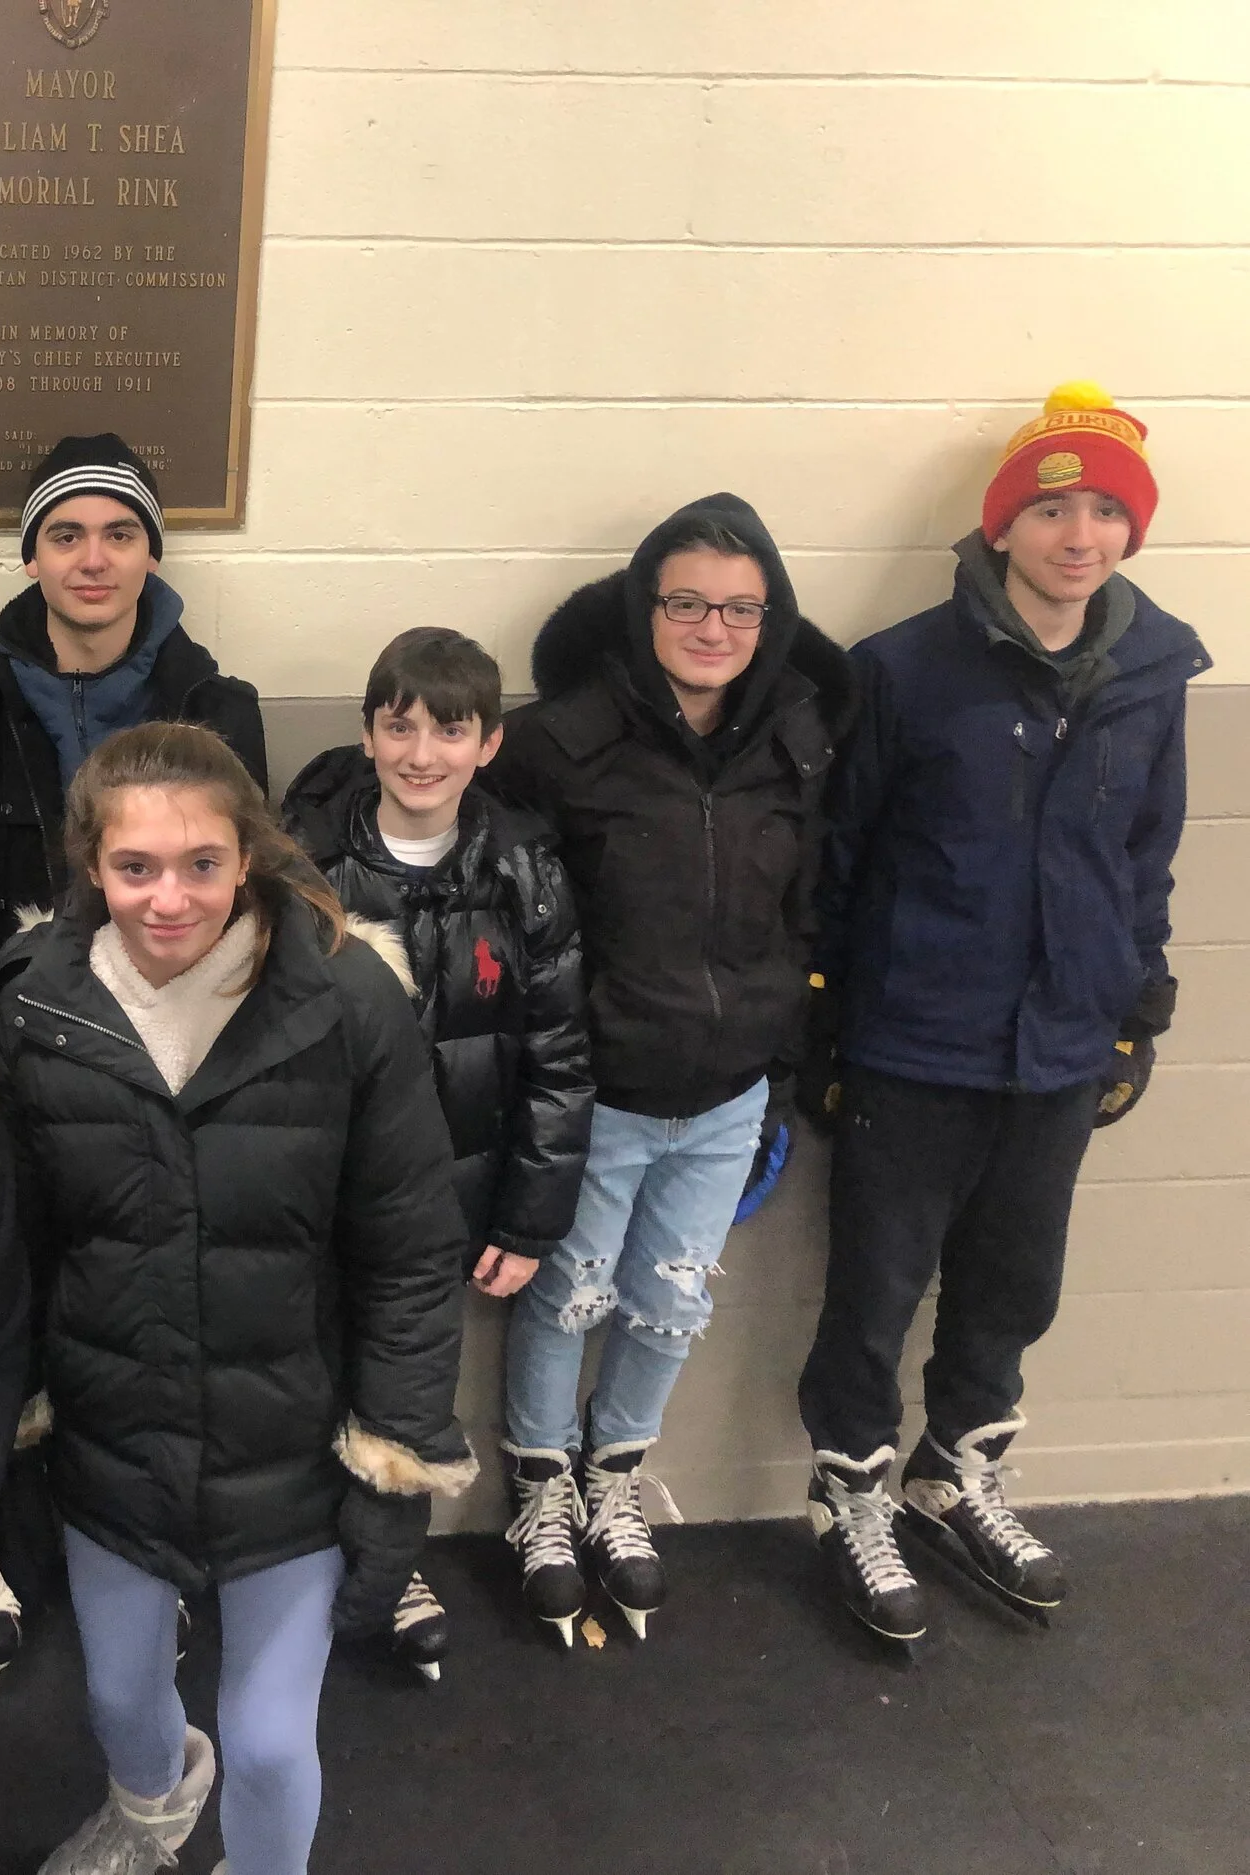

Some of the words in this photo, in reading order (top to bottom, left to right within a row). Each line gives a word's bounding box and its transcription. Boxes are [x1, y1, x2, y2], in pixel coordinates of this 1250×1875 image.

[25, 69, 117, 100] MAYOR
[119, 124, 186, 154] SHEA
[117, 177, 179, 207] RINK
[63, 244, 102, 261] 1962
[114, 245, 134, 261] BY
[144, 245, 175, 262] THE
[40, 270, 116, 287] DISTRICT
[125, 271, 226, 288] COMMISSION
[1, 325, 18, 341] IN
[29, 325, 99, 341] MEMORY
[109, 325, 129, 341] OF
[33, 350, 83, 367] CHIEF
[94, 351, 181, 367] EXECUTIVE
[29, 376, 103, 392] THROUGH
[116, 376, 151, 392] 1911
[131, 445, 166, 455] OUNDS
